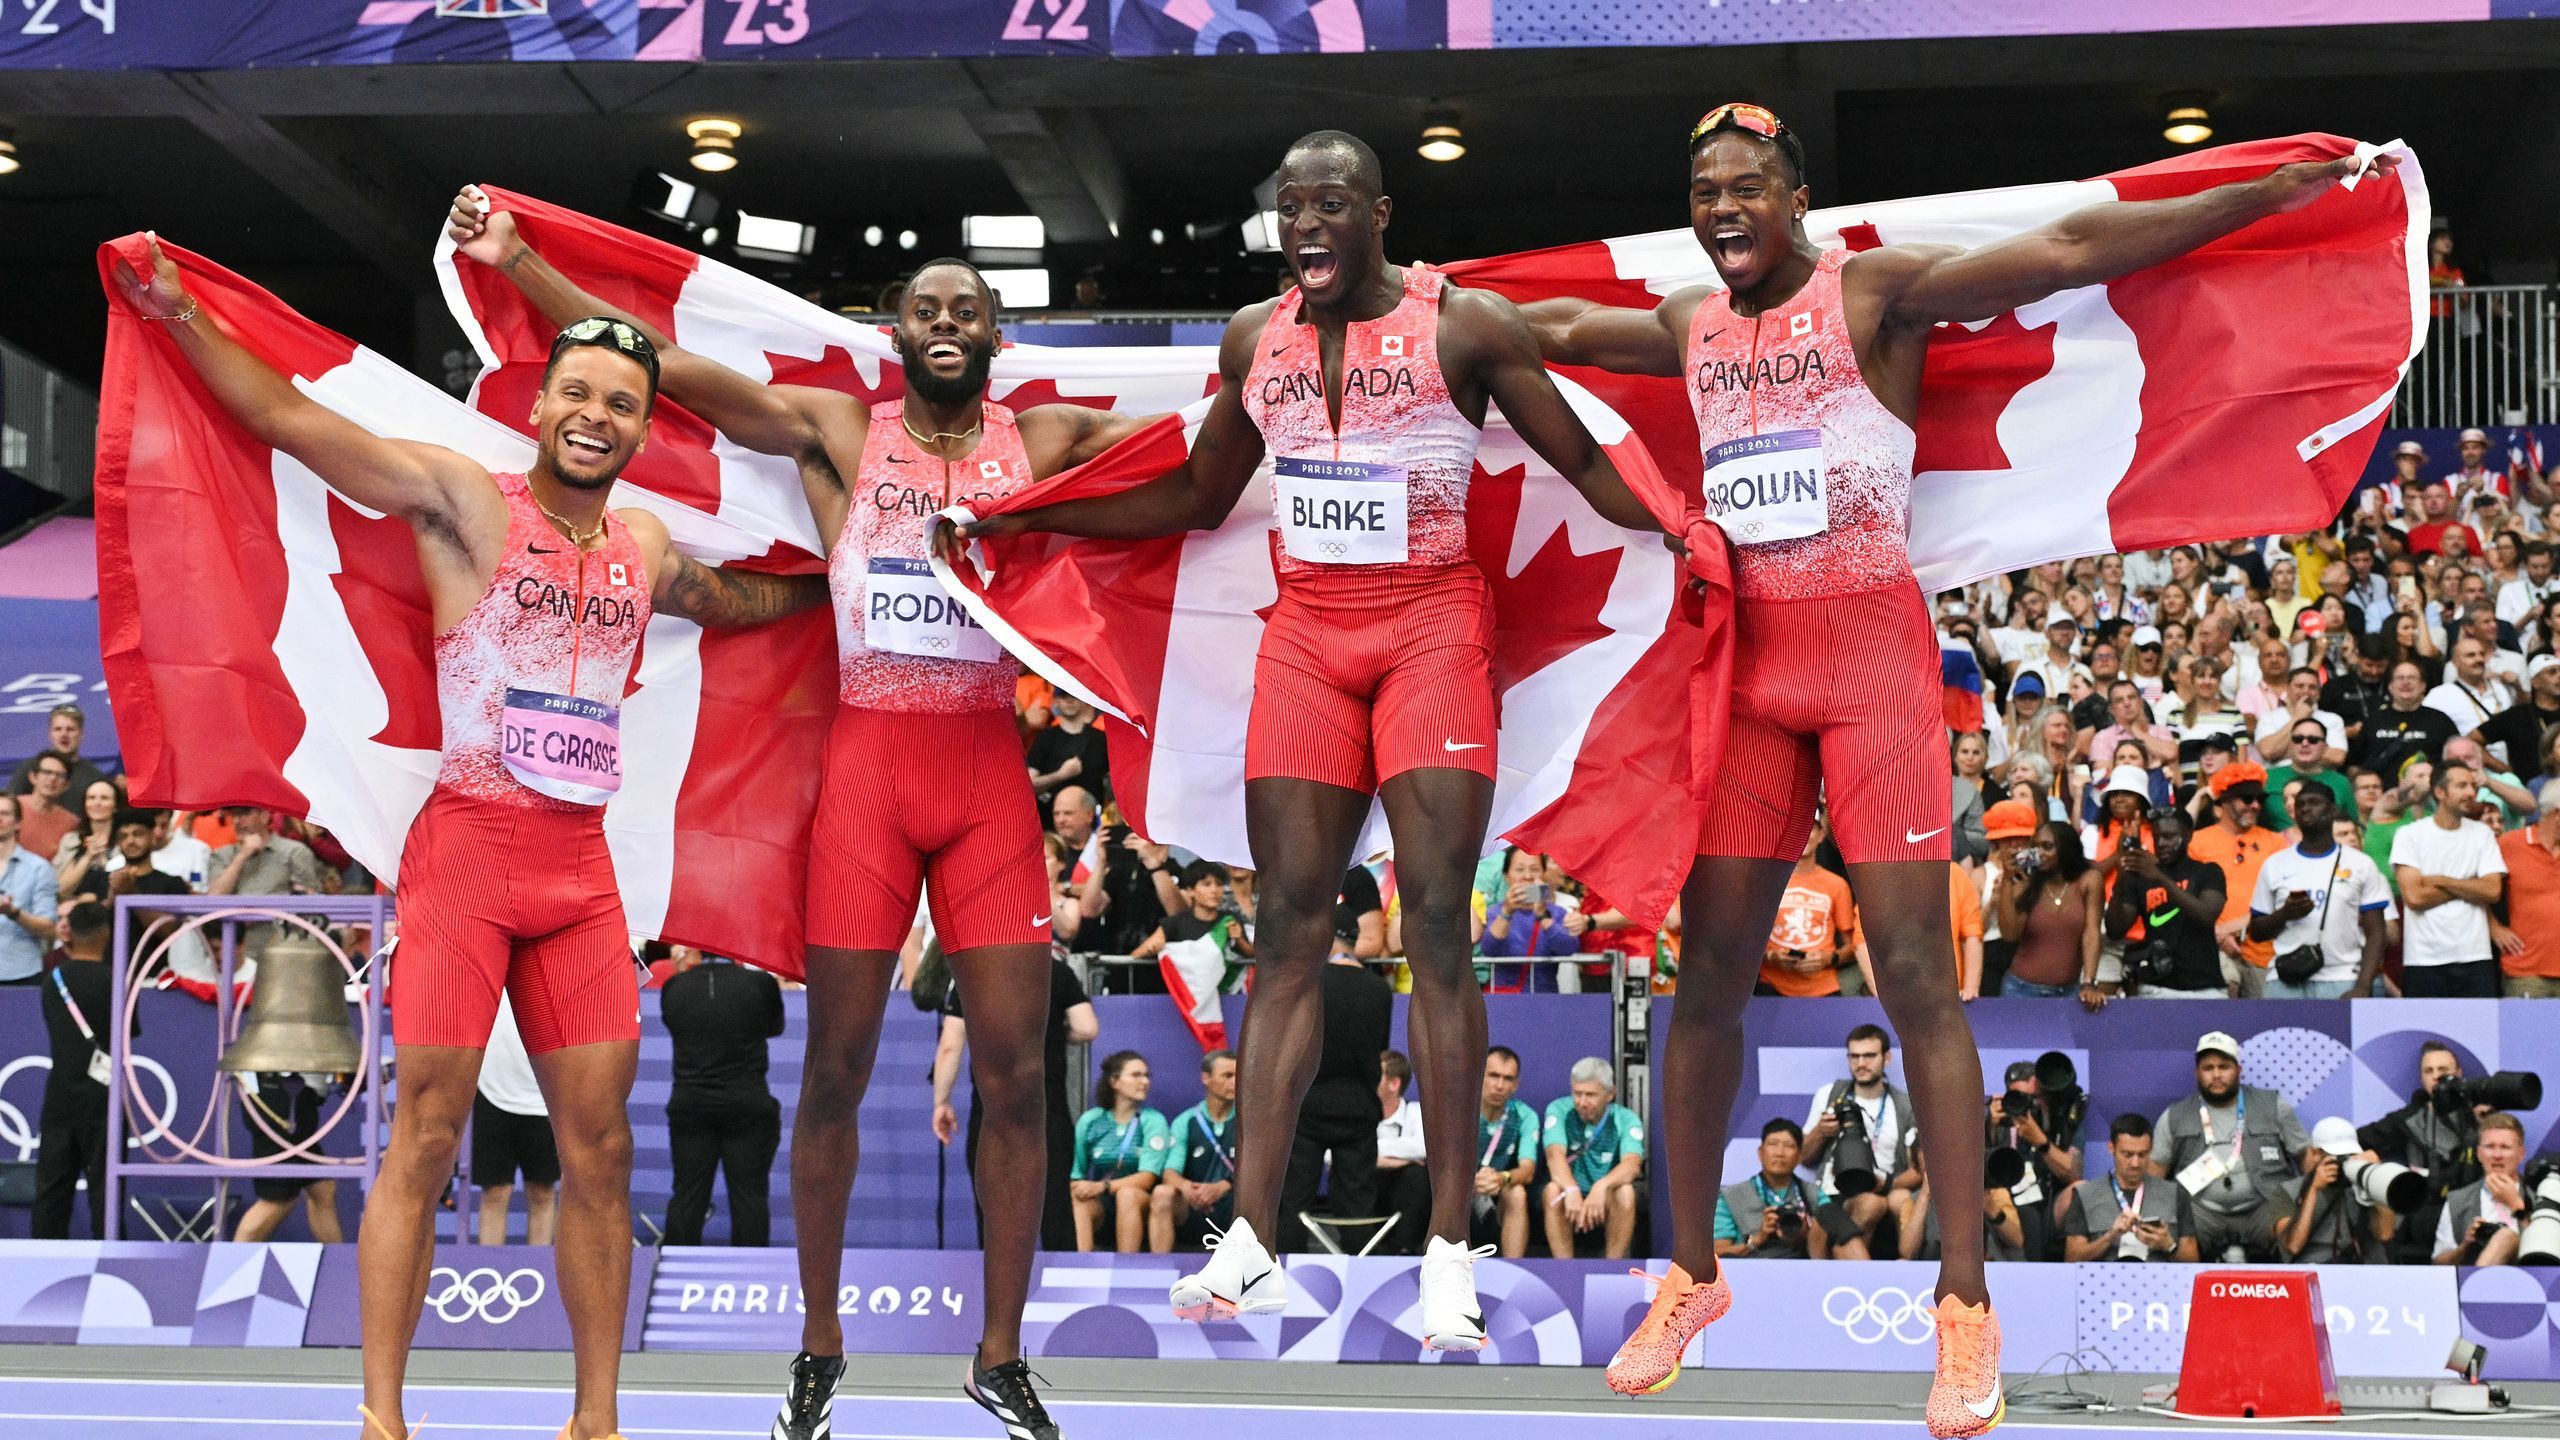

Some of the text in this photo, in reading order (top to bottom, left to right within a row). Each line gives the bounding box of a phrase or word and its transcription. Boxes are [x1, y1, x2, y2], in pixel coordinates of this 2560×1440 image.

[0, 0, 116, 34] 24
[1262, 367, 1416, 406] CANADA
[1700, 349, 1826, 394] CANADA
[1747, 438, 1779, 451] 2024
[1336, 466, 1369, 477] 2024
[1708, 468, 1818, 517] BROWN
[1293, 496, 1386, 531] BLAKE
[515, 576, 635, 628] CANADA
[544, 698, 580, 713] PARIS
[505, 724, 620, 776] DE GRASSE
[837, 1285, 964, 1316] 2024
[2229, 1283, 2289, 1299] OMEGA
